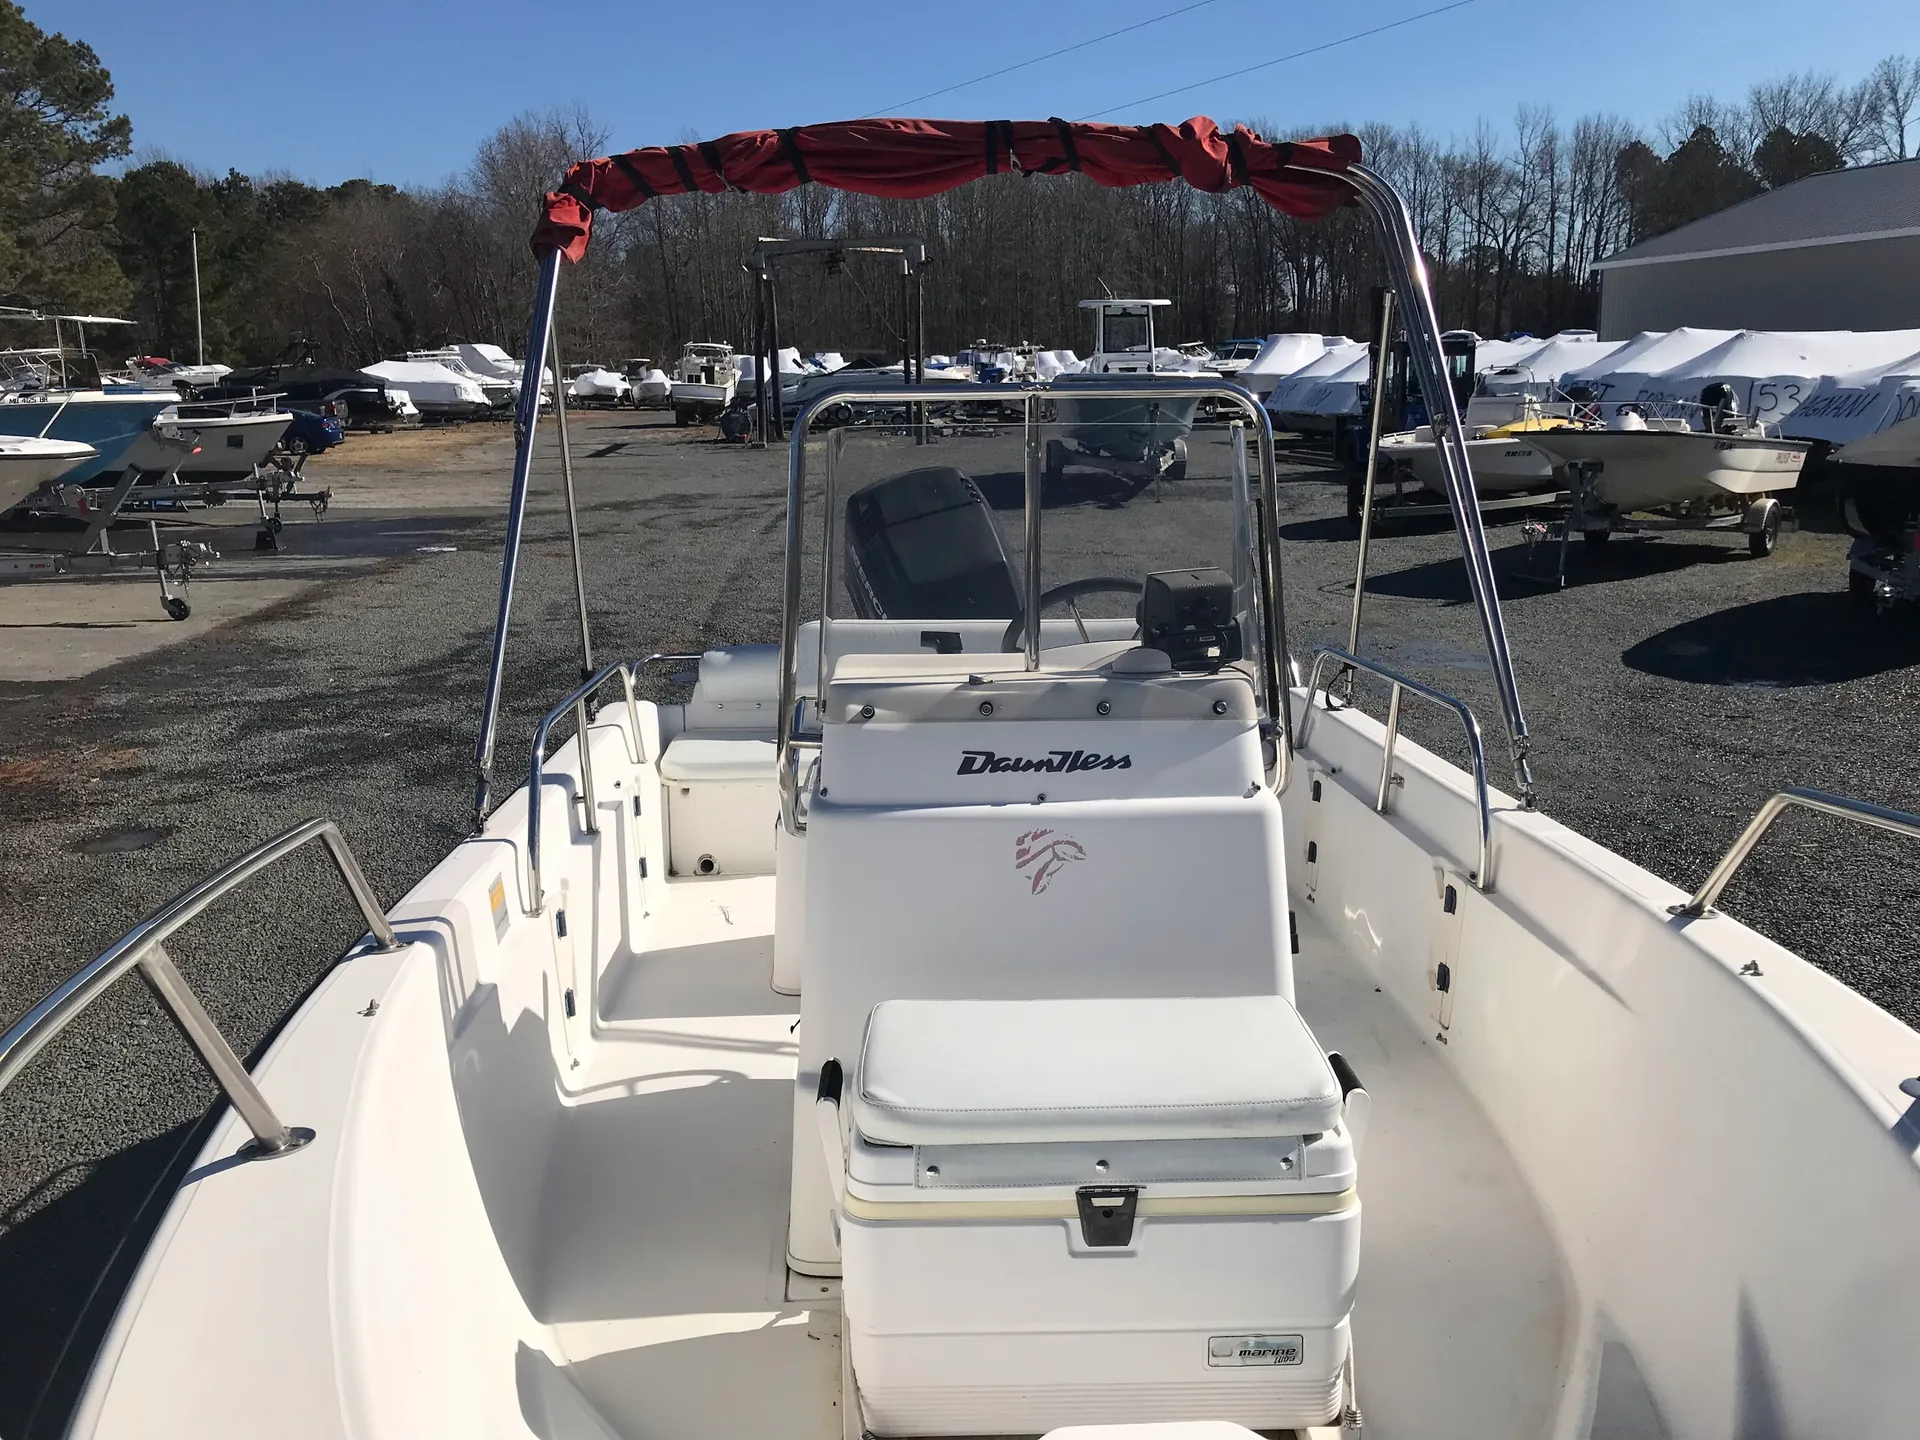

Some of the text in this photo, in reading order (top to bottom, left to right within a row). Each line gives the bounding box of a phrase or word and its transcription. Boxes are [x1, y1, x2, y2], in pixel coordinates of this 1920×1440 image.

[1747, 381, 1800, 418] 153
[1186, 582, 1215, 590] GARMIN
[1238, 1348, 1296, 1357] marine
